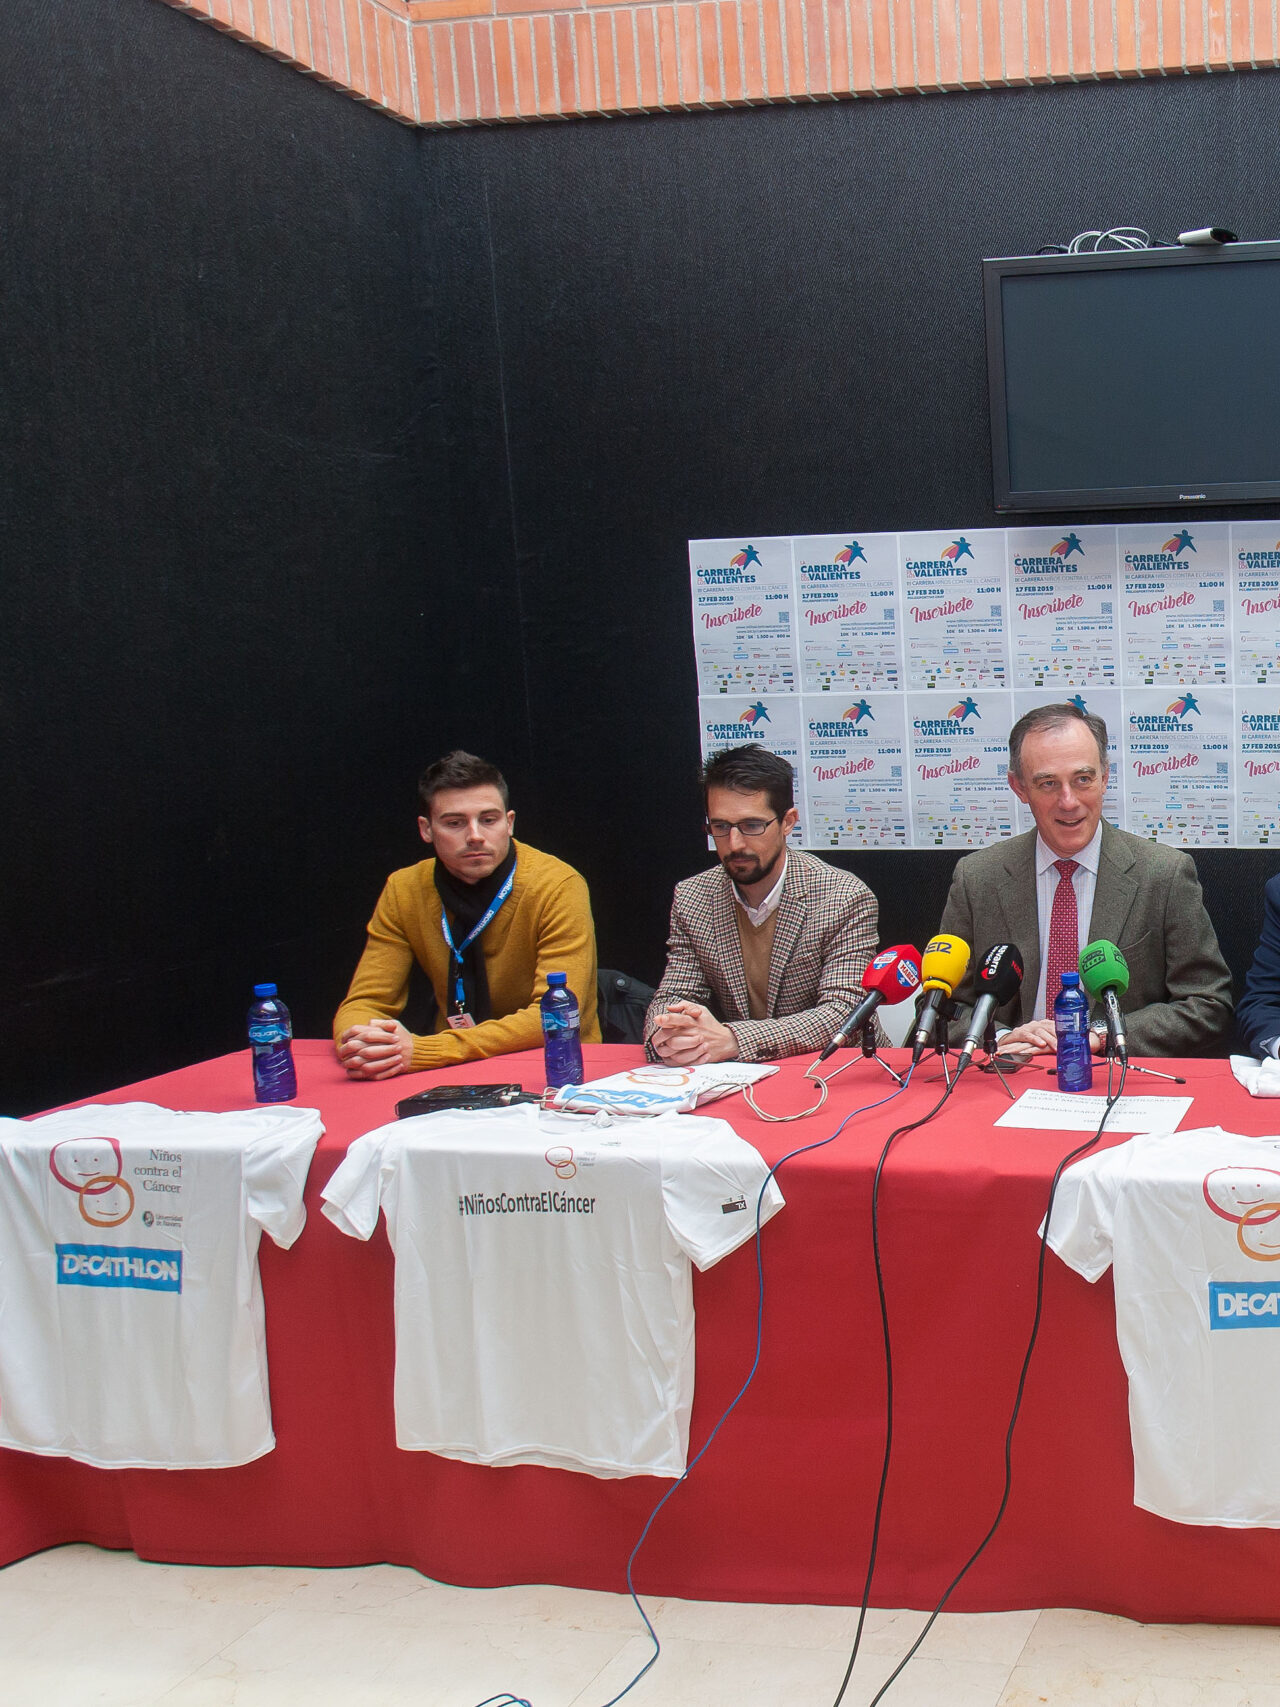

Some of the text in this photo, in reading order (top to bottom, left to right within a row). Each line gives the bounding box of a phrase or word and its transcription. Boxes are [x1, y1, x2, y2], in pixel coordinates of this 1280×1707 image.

[1015, 557, 1062, 565] CARRERA
[1125, 554, 1174, 562] CARRERA
[801, 564, 846, 573] CARRERA
[906, 560, 952, 569] CARRERA
[1023, 564, 1077, 573] VALIENTES
[1133, 561, 1189, 570] VALIENTES
[697, 568, 741, 576] CARRERA
[809, 572, 860, 580] VALIENTES
[914, 568, 967, 577] VALIENTES
[705, 575, 755, 584] VALIENTES
[1018, 593, 1084, 619] Inscríbete
[1128, 591, 1195, 617] Inscríbete
[804, 600, 867, 625] Inscríbete
[909, 597, 974, 622] Inscríbete
[701, 603, 763, 628] Inscríbete
[914, 719, 959, 728] CARRERA
[1130, 715, 1178, 724] CARRERA
[707, 724, 751, 732] CARRERA
[809, 721, 854, 730] CARRERA
[1138, 723, 1193, 732] VALIENTES
[714, 731, 764, 739] VALIENTES
[817, 729, 868, 737] VALIENTES
[922, 727, 973, 735] VALIENTES
[813, 757, 875, 781] Inscríbete
[917, 755, 980, 780] Inscríbete
[1132, 752, 1199, 777] Inscríbete
[150, 1149, 182, 1163] Niños
[133, 1165, 182, 1178] contra el
[142, 1180, 182, 1194] Cáncer
[459, 1190, 596, 1216] #NiñosContraElCáncer
[62, 1254, 179, 1281] DECATHLON
